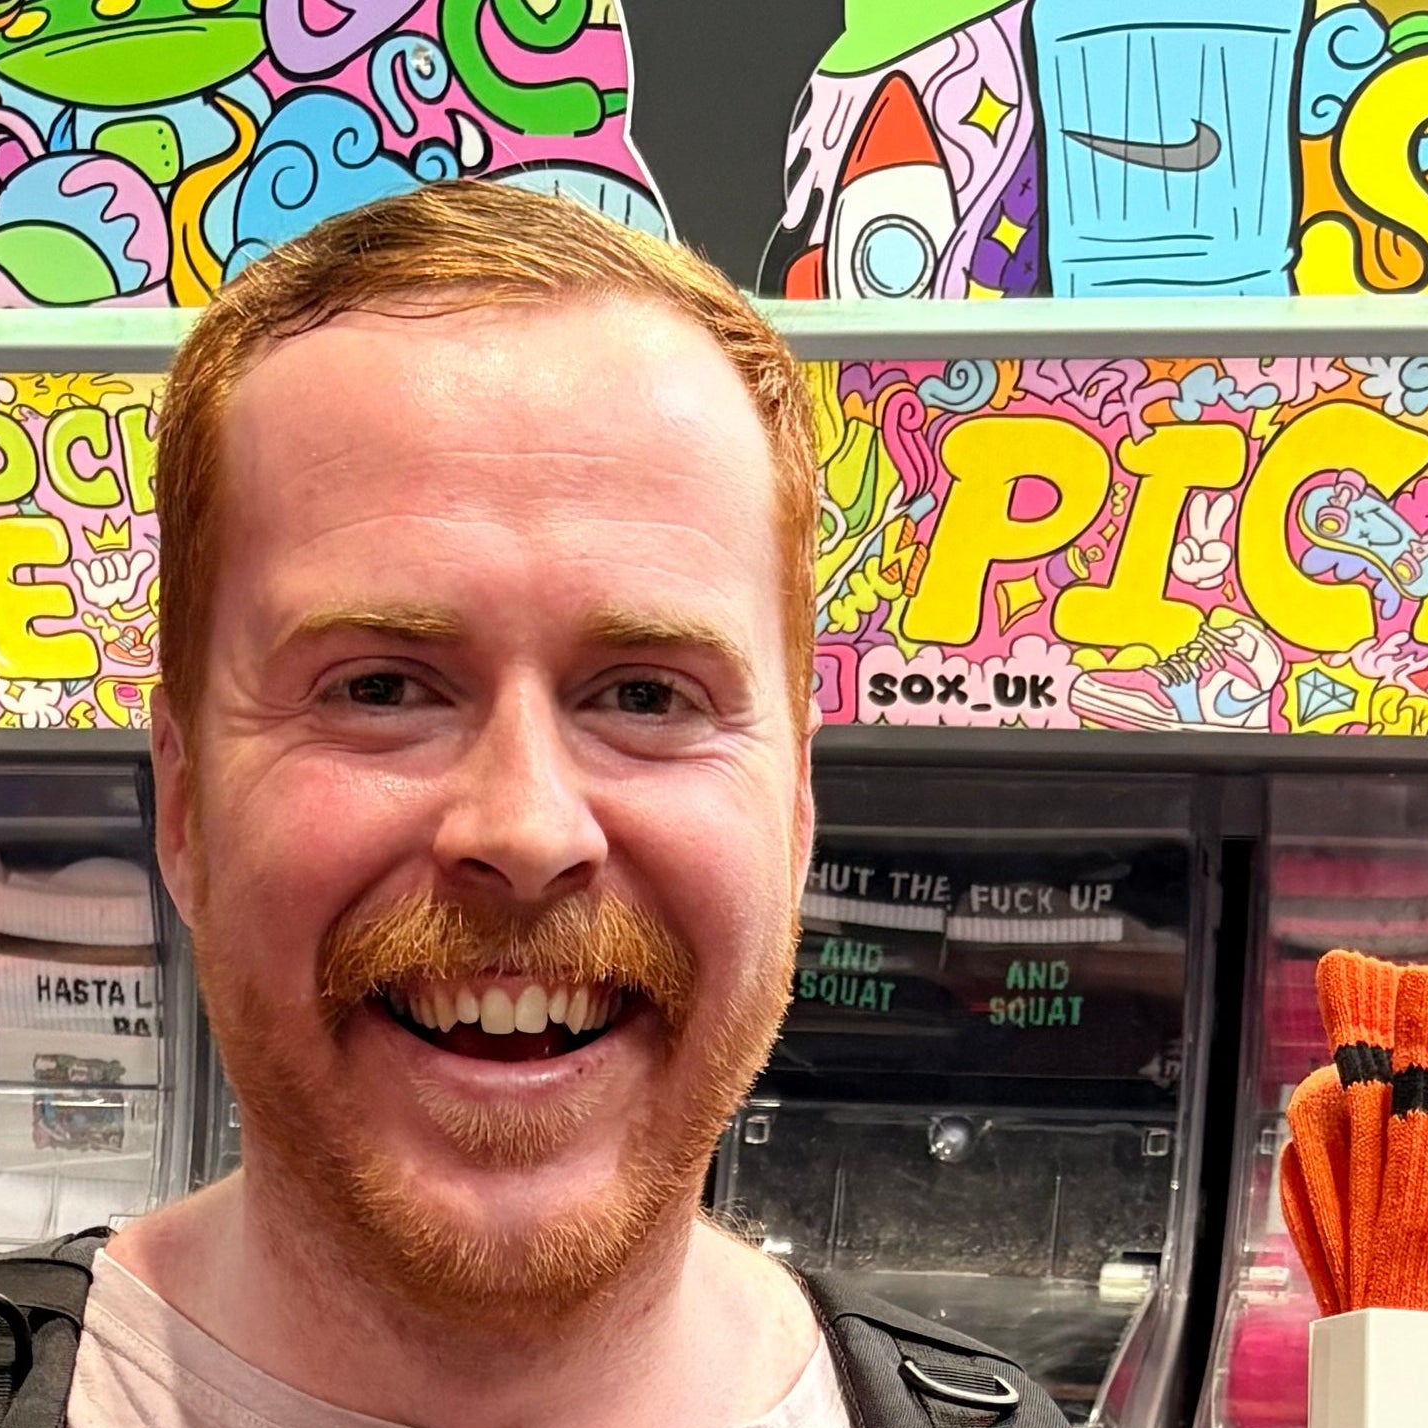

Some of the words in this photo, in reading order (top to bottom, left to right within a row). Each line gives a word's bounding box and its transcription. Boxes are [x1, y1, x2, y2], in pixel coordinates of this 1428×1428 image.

[868, 671, 1059, 710] SOX_UK
[808, 861, 876, 897] HUT
[970, 882, 1055, 915] FUCK
[1070, 882, 1115, 914] UP
[819, 936, 884, 973] AND
[36, 974, 125, 1008] HASTA
[800, 973, 896, 1013] SQUAT
[1005, 960, 1070, 991] AND
[988, 996, 1084, 1029] SQUAT
